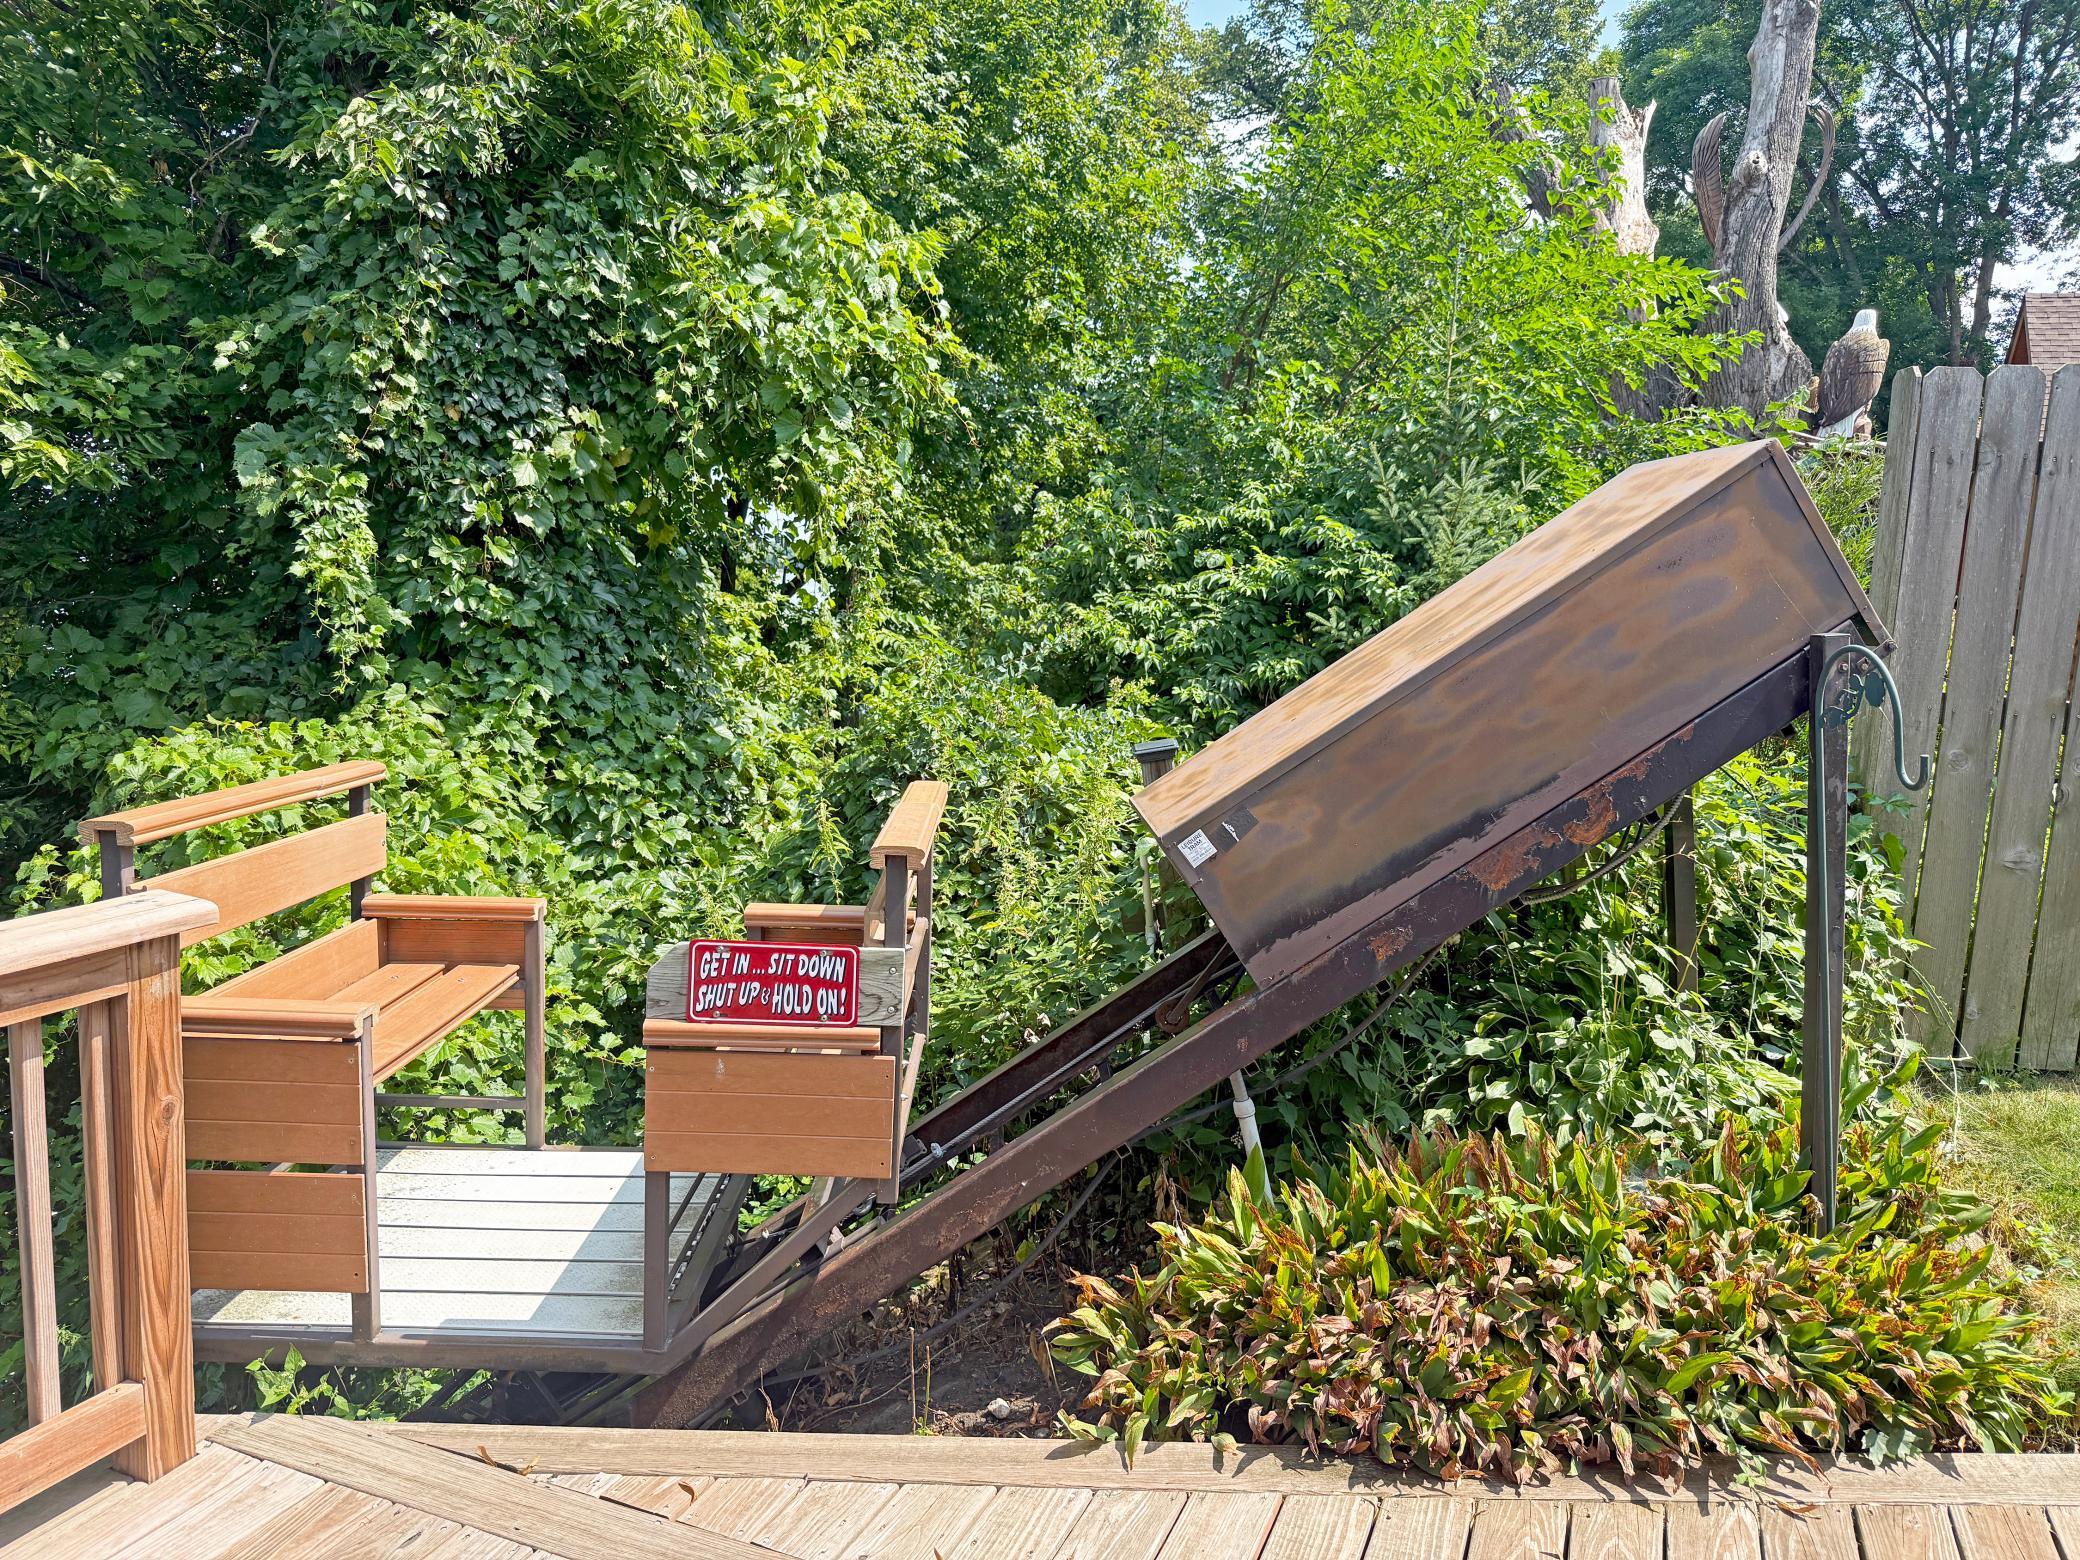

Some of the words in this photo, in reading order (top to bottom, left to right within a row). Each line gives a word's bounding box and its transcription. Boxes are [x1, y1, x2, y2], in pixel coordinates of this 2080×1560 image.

[1187, 838, 1203, 852] TRAM
[700, 951, 731, 980] GET
[768, 952, 796, 976] SIT
[798, 954, 846, 983] DOWN
[696, 982, 737, 1013] SHUT
[738, 982, 760, 1006] UP
[761, 988, 771, 1006] &
[772, 983, 814, 1015] HOLD
[816, 987, 847, 1016] ON!
